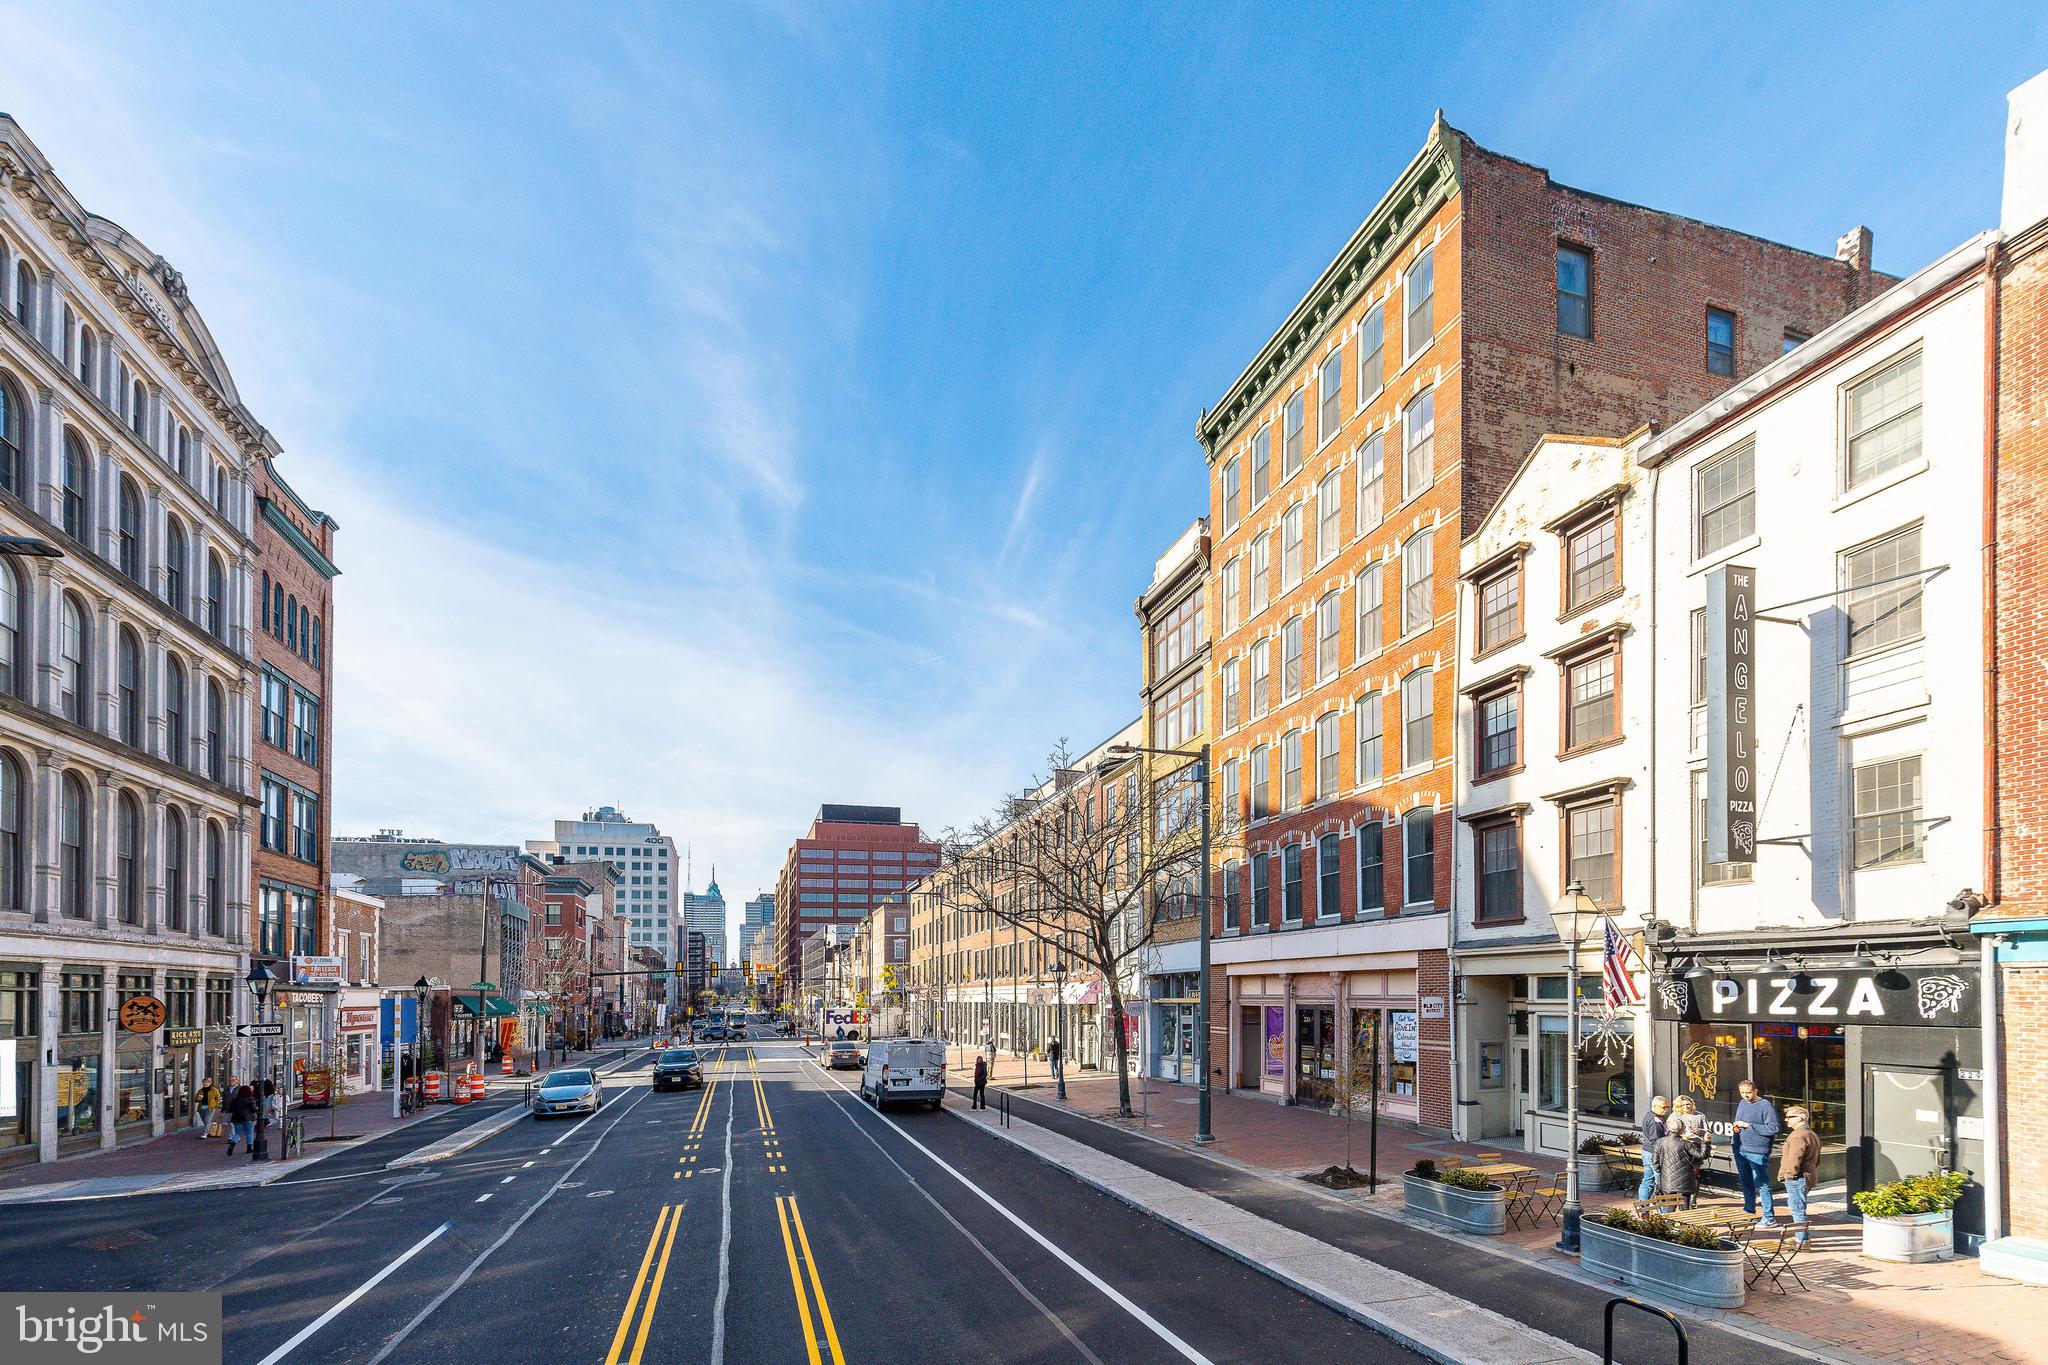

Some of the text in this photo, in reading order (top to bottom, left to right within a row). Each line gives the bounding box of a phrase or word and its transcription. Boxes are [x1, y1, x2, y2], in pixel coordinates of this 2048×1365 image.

[1733, 574, 1749, 587] THE
[1733, 594, 1749, 793] ANGELO
[1730, 800, 1754, 813] PIZZA
[292, 992, 324, 1003] TACOBEE'S
[1712, 977, 1885, 1016] PIZZA
[826, 1009, 868, 1024] FedEx
[171, 1030, 202, 1039] KICK AXE
